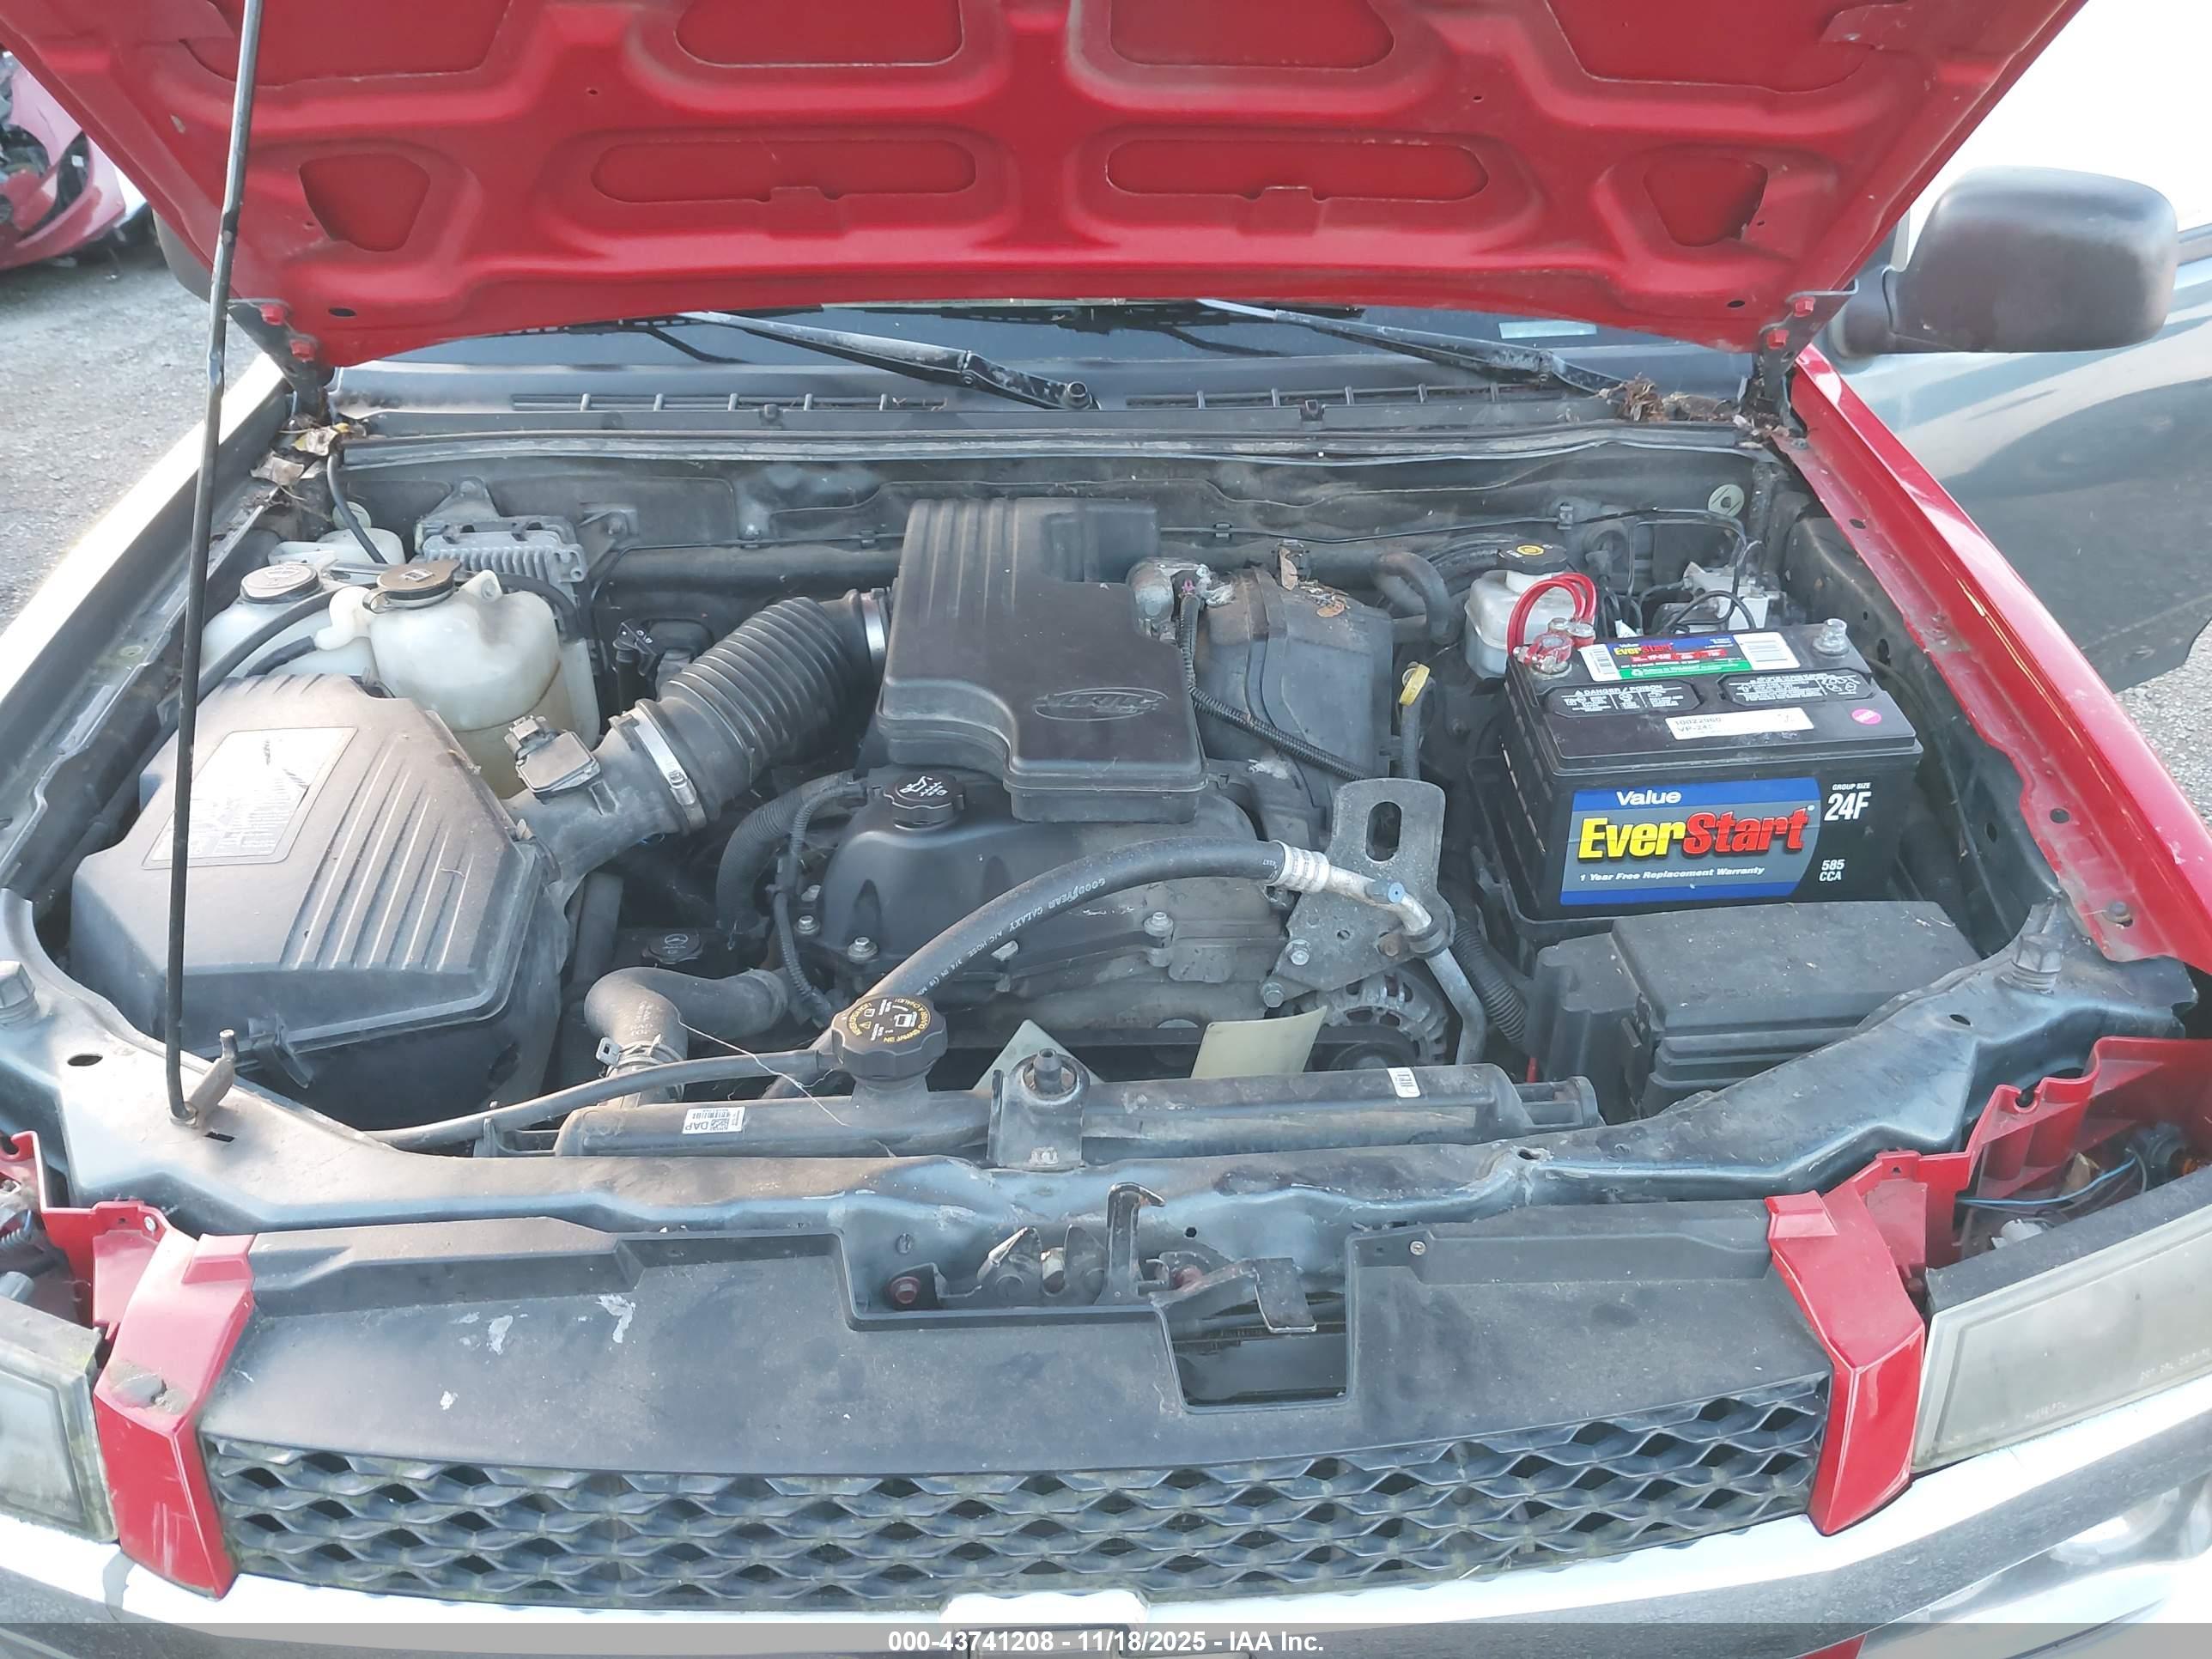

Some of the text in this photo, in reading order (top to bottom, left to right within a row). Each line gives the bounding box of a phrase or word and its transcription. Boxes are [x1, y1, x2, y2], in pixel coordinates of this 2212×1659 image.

[1613, 643, 1673, 656] EverStart
[1583, 687, 1621, 696] DANGER
[1616, 790, 1681, 805] Value
[1824, 792, 1872, 821] 24F
[1577, 808, 1808, 860] EverStart
[1821, 859, 1845, 871] 585
[1590, 872, 1613, 881] Year
[1616, 871, 1639, 880] Free
[1643, 867, 1715, 879] Replacement
[1717, 866, 1765, 877] Warranty
[1819, 871, 1842, 882] CCA
[1048, 878, 1106, 908] GOODYEAR
[1009, 906, 1043, 932] GALAXY
[968, 940, 988, 957] HOSE
[685, 1121, 708, 1132] DAP
